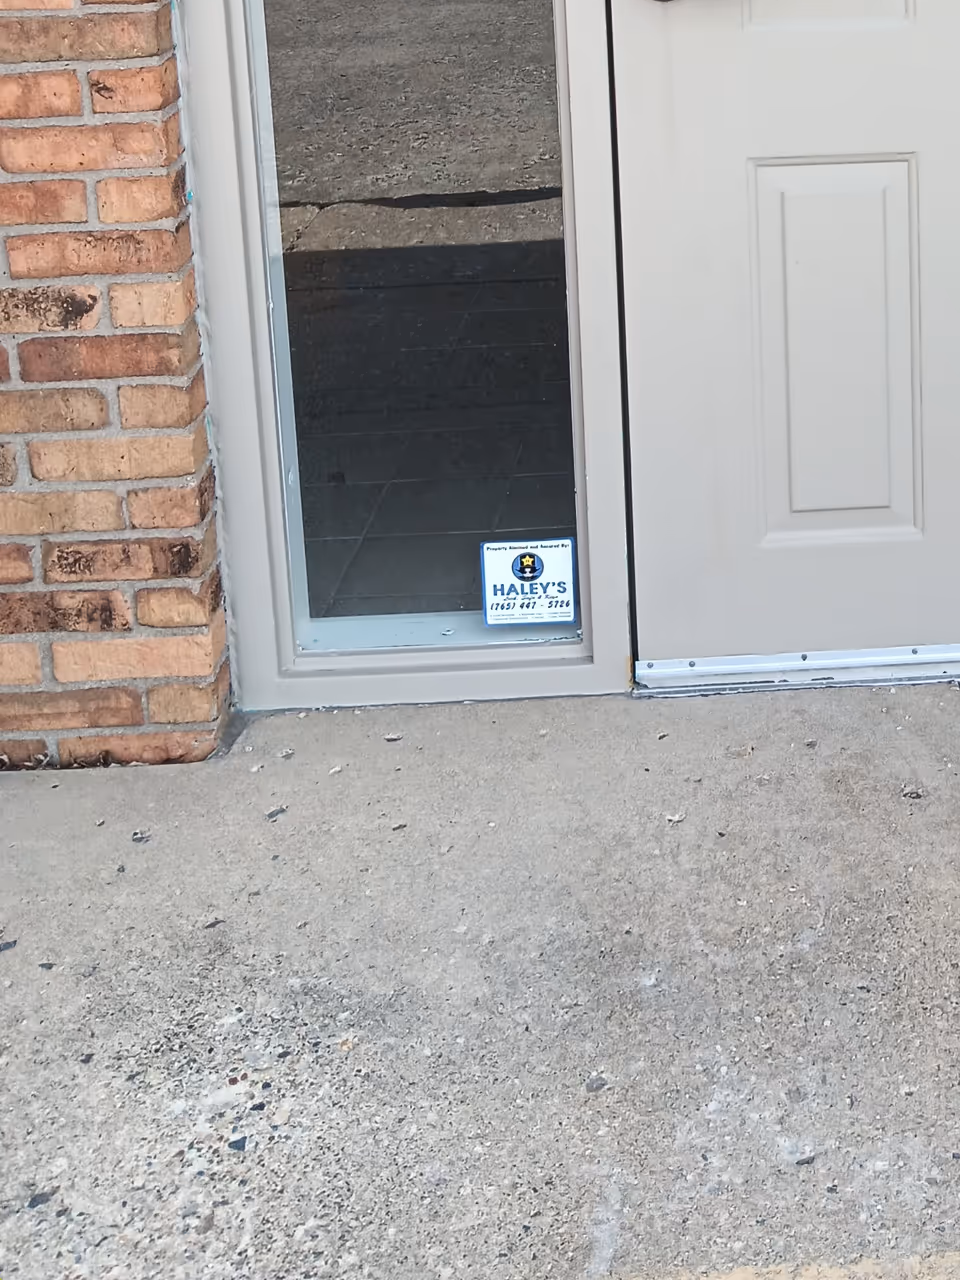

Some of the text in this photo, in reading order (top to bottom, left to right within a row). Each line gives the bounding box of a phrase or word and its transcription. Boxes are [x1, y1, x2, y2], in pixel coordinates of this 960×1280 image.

[493, 581, 567, 596] HALEY'S
[490, 602, 516, 611] (765)
[519, 601, 537, 610] 447
[547, 600, 570, 609] 5726
